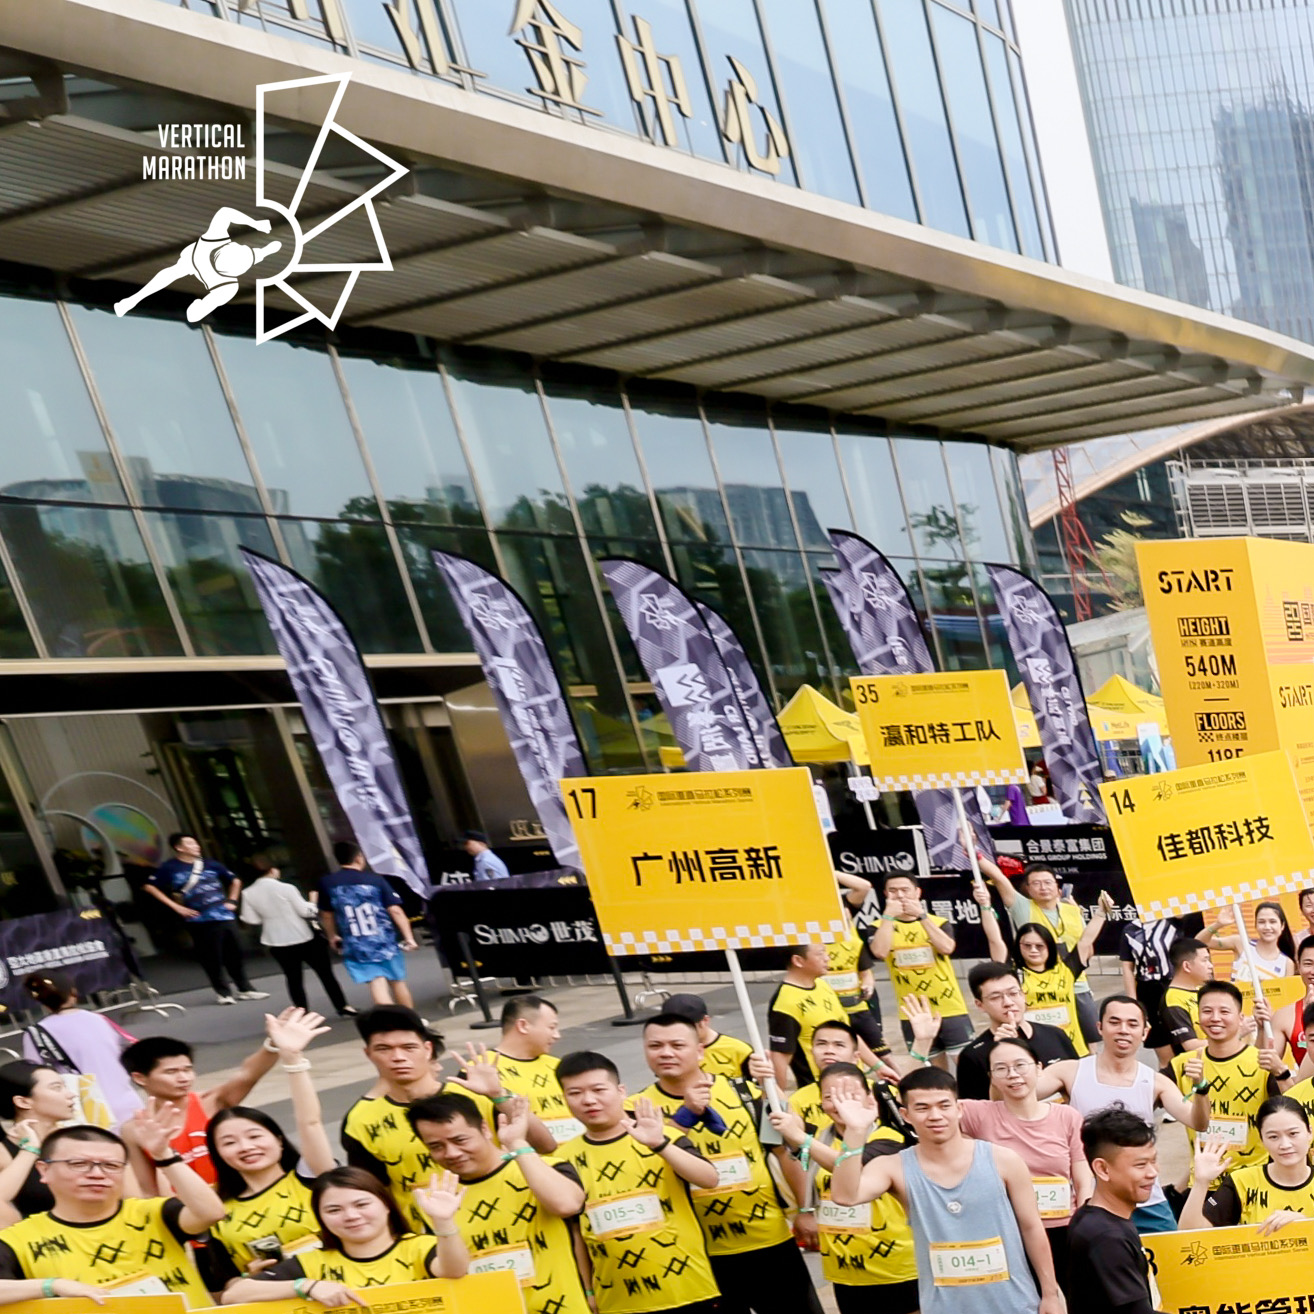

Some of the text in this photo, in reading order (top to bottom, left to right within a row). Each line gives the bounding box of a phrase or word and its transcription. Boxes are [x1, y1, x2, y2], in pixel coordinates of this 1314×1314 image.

[1158, 569, 1234, 594] START
[1178, 617, 1229, 637] HEIGHT
[1184, 654, 1237, 678] 540M
[856, 684, 880, 704] 35
[1279, 685, 1313, 708] START
[1196, 712, 1245, 731] FLOORS
[568, 788, 598, 819] 17
[1110, 789, 1136, 815] 14
[1026, 838, 1105, 853] 合景泰富集团
[1157, 816, 1274, 862] 佳都科技
[630, 846, 784, 886] 广州高新
[922, 900, 981, 924] 置地
[550, 919, 598, 943] 世茂
[603, 1203, 646, 1221] 015-3
[1212, 1238, 1307, 1255] 国际垂直马拉松系列赛
[951, 1254, 992, 1268] 014-1
